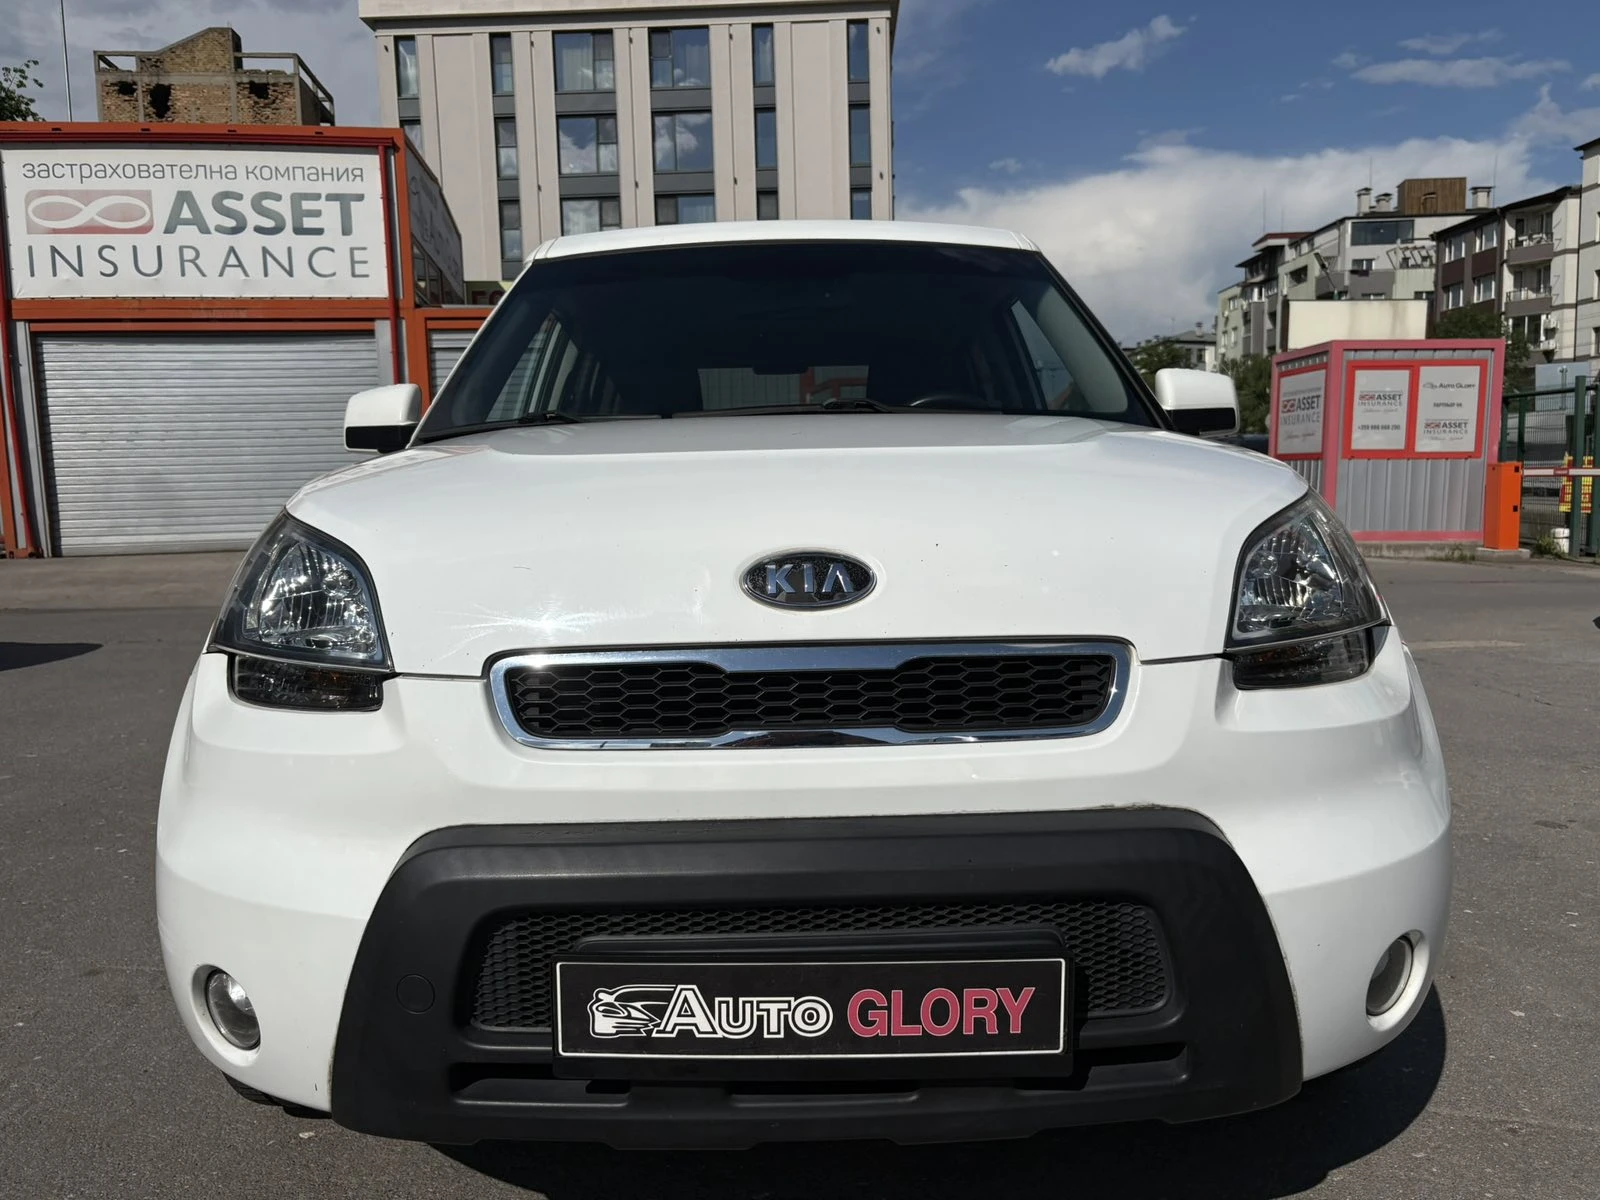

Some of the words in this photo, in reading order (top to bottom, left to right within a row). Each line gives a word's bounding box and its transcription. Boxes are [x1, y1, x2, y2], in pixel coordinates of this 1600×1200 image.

[22, 162, 237, 184] застрахователна
[245, 165, 364, 182] компания
[163, 190, 365, 236] ASSET
[27, 244, 370, 278] INSURANCE
[1280, 411, 1320, 425] INSURANCE
[1296, 395, 1321, 411] ASSET
[765, 563, 854, 594] KIA
[847, 987, 1036, 1037] GLORY
